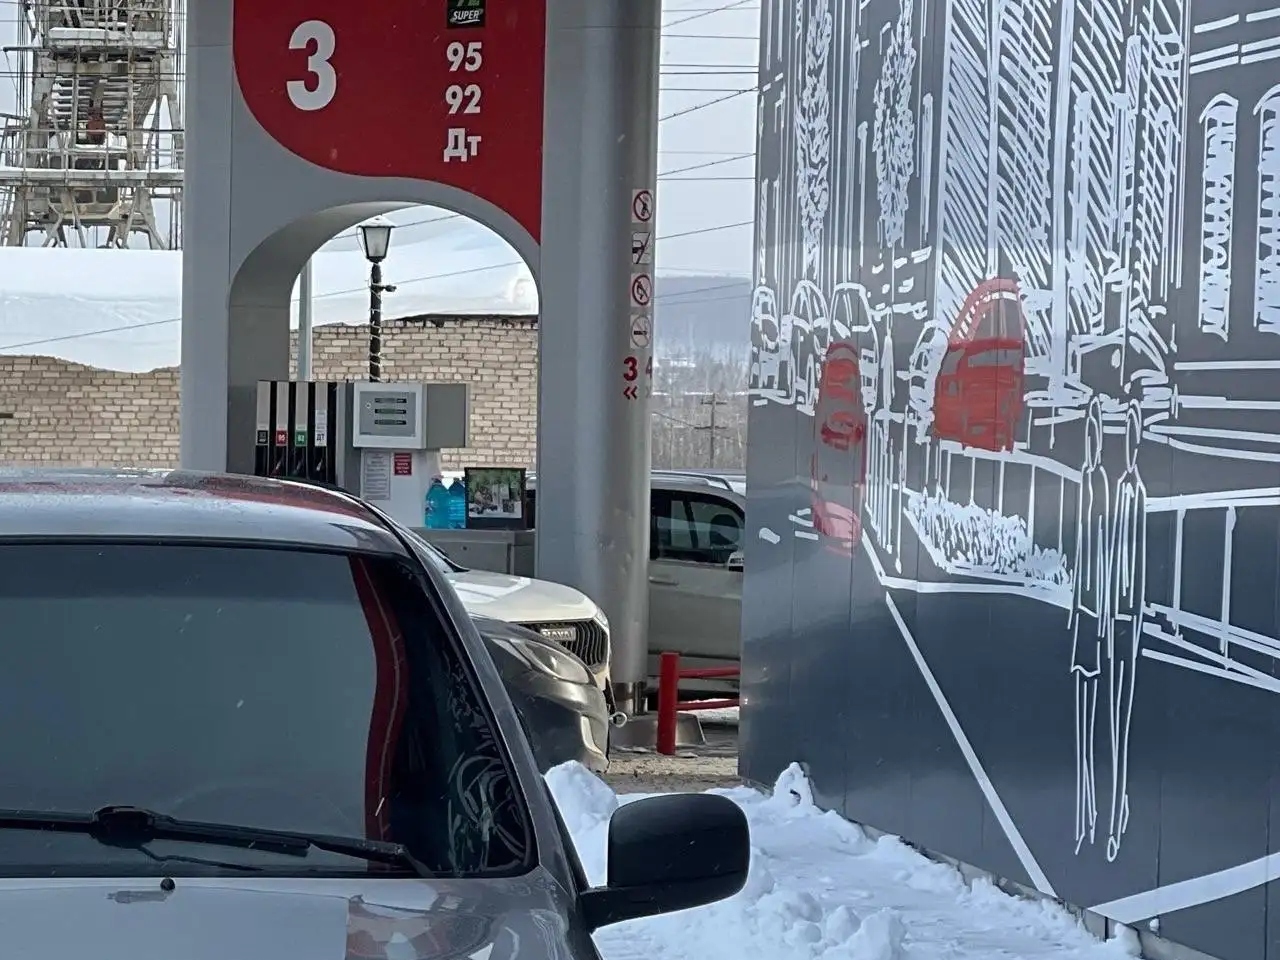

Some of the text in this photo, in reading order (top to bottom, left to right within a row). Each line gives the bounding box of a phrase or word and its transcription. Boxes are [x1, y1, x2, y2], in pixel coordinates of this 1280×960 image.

[453, 10, 480, 20] SUPER
[287, 20, 337, 111] 3
[447, 42, 482, 72] 95
[446, 84, 482, 114] 92
[444, 128, 482, 163] Дт
[623, 356, 638, 382] 3
